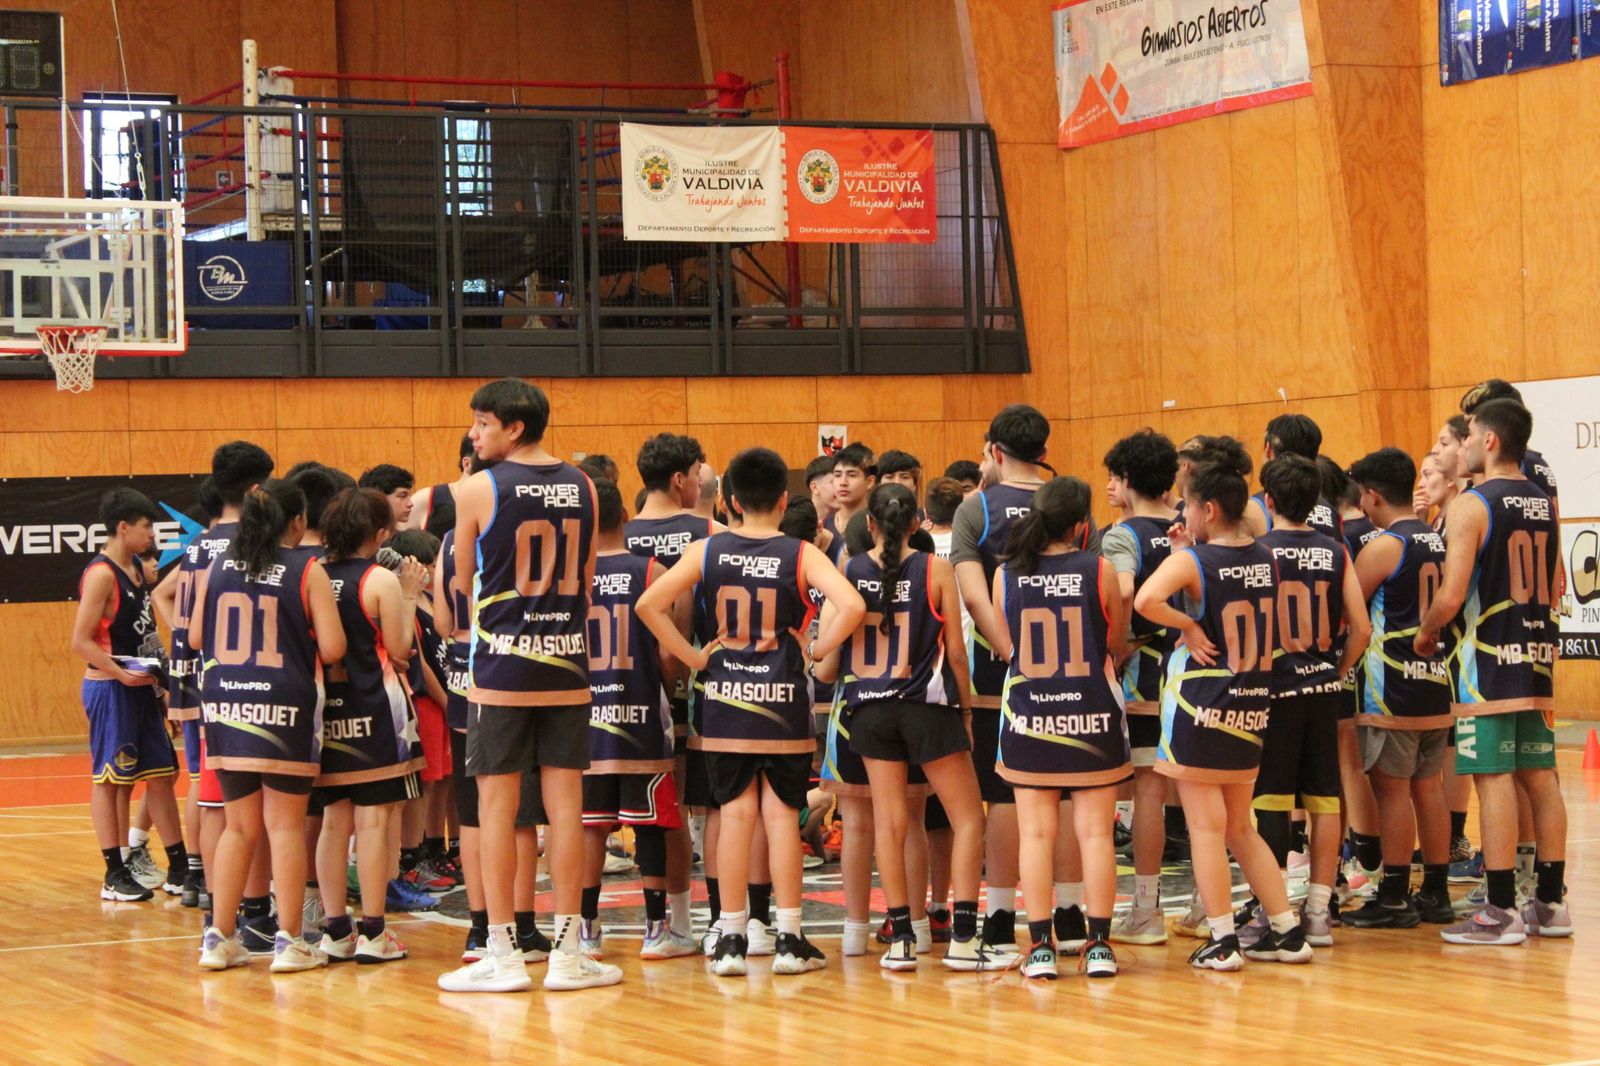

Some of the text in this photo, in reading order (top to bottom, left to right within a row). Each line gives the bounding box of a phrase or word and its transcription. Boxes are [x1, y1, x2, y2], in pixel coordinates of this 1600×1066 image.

[1105, 1, 1118, 12] ESTE
[682, 168, 761, 176] MUNICIPALIDAD DE
[843, 170, 919, 179] MUNICIPALIDAD DE
[682, 177, 764, 190] VALDIVIA
[843, 179, 923, 193] VALDIVIA
[685, 193, 767, 213] Trabajando Juntos
[848, 195, 925, 215] Trabajando Juntos
[638, 224, 692, 232] DEPARTAMENTO
[694, 225, 725, 233] DEPORTE
[799, 226, 851, 234] DEPARTAMENTO
[515, 484, 579, 497] POWER
[544, 496, 580, 508] ADE
[1502, 496, 1549, 509] POWER
[1523, 508, 1550, 521] ADE
[628, 532, 692, 548] POWER
[515, 518, 581, 597] 01
[718, 553, 781, 568] POWER
[1272, 547, 1334, 561] POWER
[1219, 563, 1271, 580] POWER
[1298, 558, 1334, 571] ADE
[1507, 530, 1550, 605] 01
[742, 566, 780, 579] ADE
[592, 574, 632, 586] OWER
[1018, 574, 1083, 588] POWER
[1244, 575, 1273, 588] ADE
[600, 585, 631, 595] ADE
[1044, 585, 1082, 597] ADE
[530, 611, 571, 621] LivePRO
[716, 585, 779, 652] 01
[1277, 580, 1332, 653] 01
[214, 592, 284, 668] 01
[586, 603, 634, 671] 01
[1221, 597, 1273, 675] 01
[851, 611, 912, 679] 01
[1019, 606, 1091, 679] 01
[227, 680, 272, 691] LivePRO
[721, 681, 795, 703] BASQUET
[1238, 687, 1269, 697] LivePRO
[1039, 691, 1082, 702] LivePRO
[219, 702, 299, 728] BASQUET
[591, 705, 649, 724] BASQUET
[323, 716, 373, 741] SQUET
[1032, 712, 1111, 736] BASQUET
